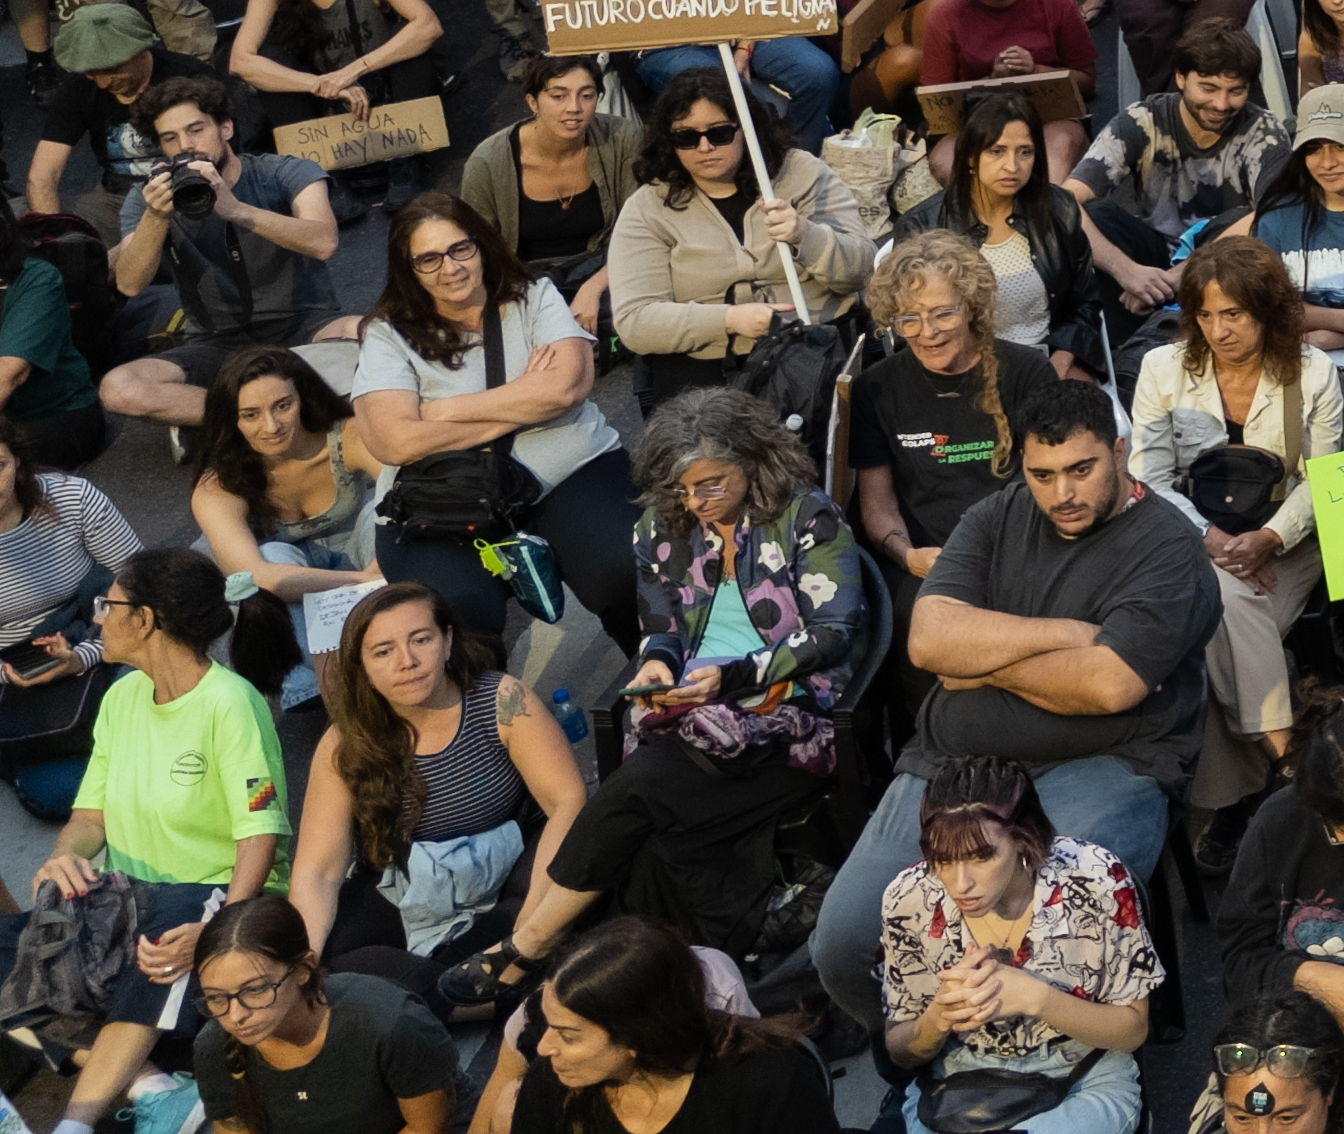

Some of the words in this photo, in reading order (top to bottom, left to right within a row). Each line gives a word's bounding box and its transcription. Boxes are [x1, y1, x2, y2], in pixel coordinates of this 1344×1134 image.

[925, 93, 954, 111] NO
[298, 126, 329, 144] SIN
[341, 113, 395, 137] AGUA
[331, 137, 368, 163] HAY
[382, 123, 432, 149] NADA
[935, 440, 994, 454] ORGANIZAR
[947, 450, 996, 464] RESPUES
